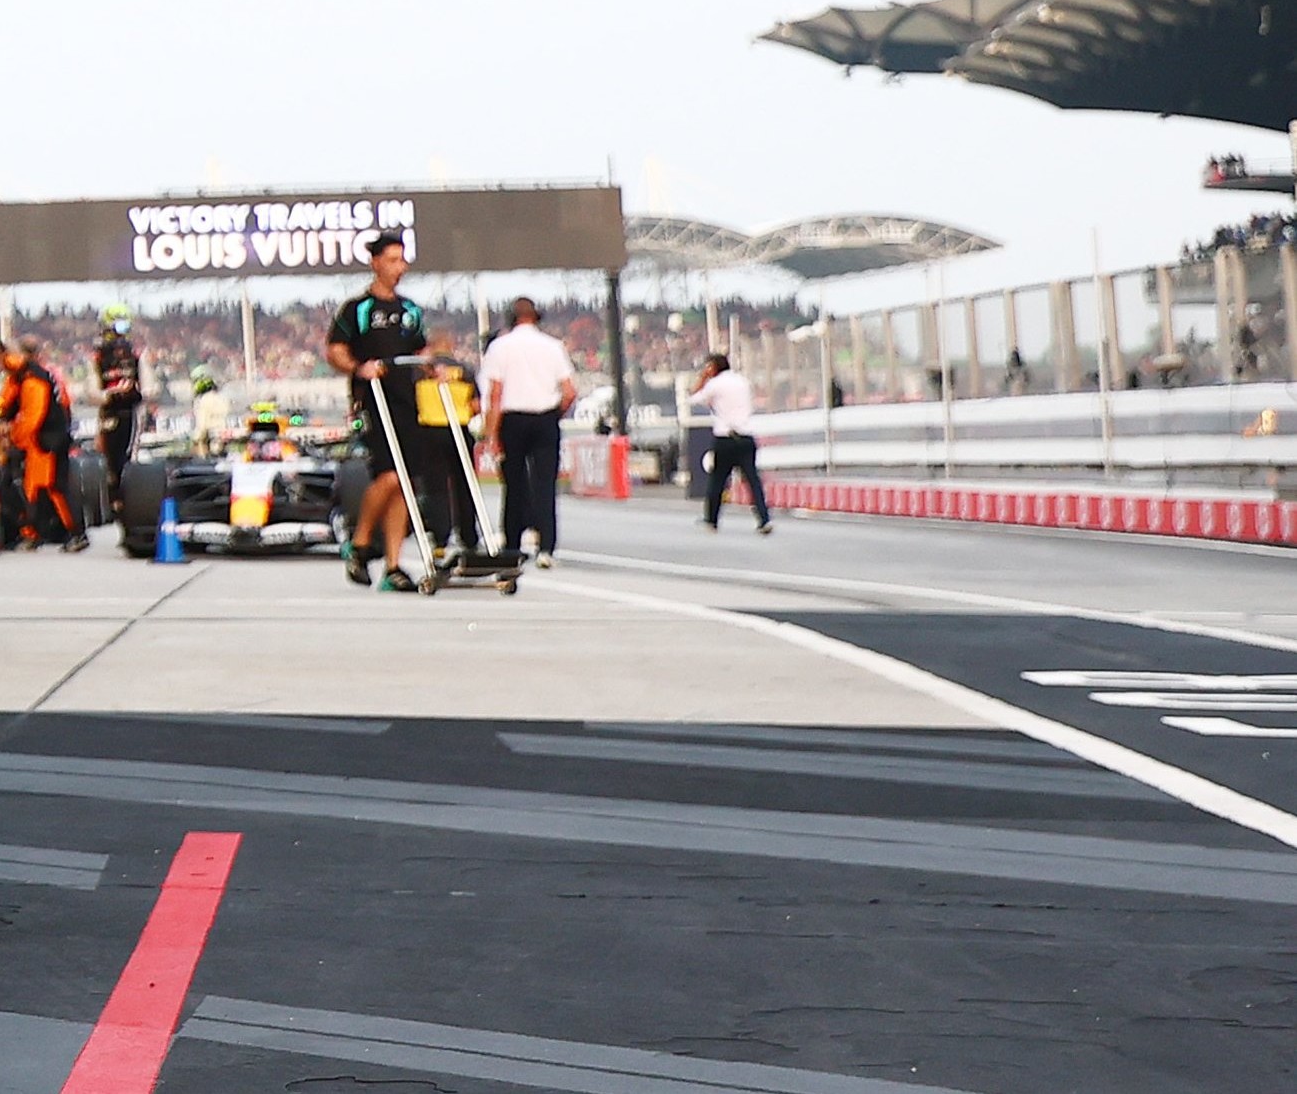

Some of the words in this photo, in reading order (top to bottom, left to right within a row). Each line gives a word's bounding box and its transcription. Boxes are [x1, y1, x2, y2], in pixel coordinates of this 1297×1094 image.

[128, 204, 250, 234] VICTORY
[253, 200, 374, 231] TRAVELS
[377, 199, 415, 229] IN
[132, 233, 248, 272] LOUIS
